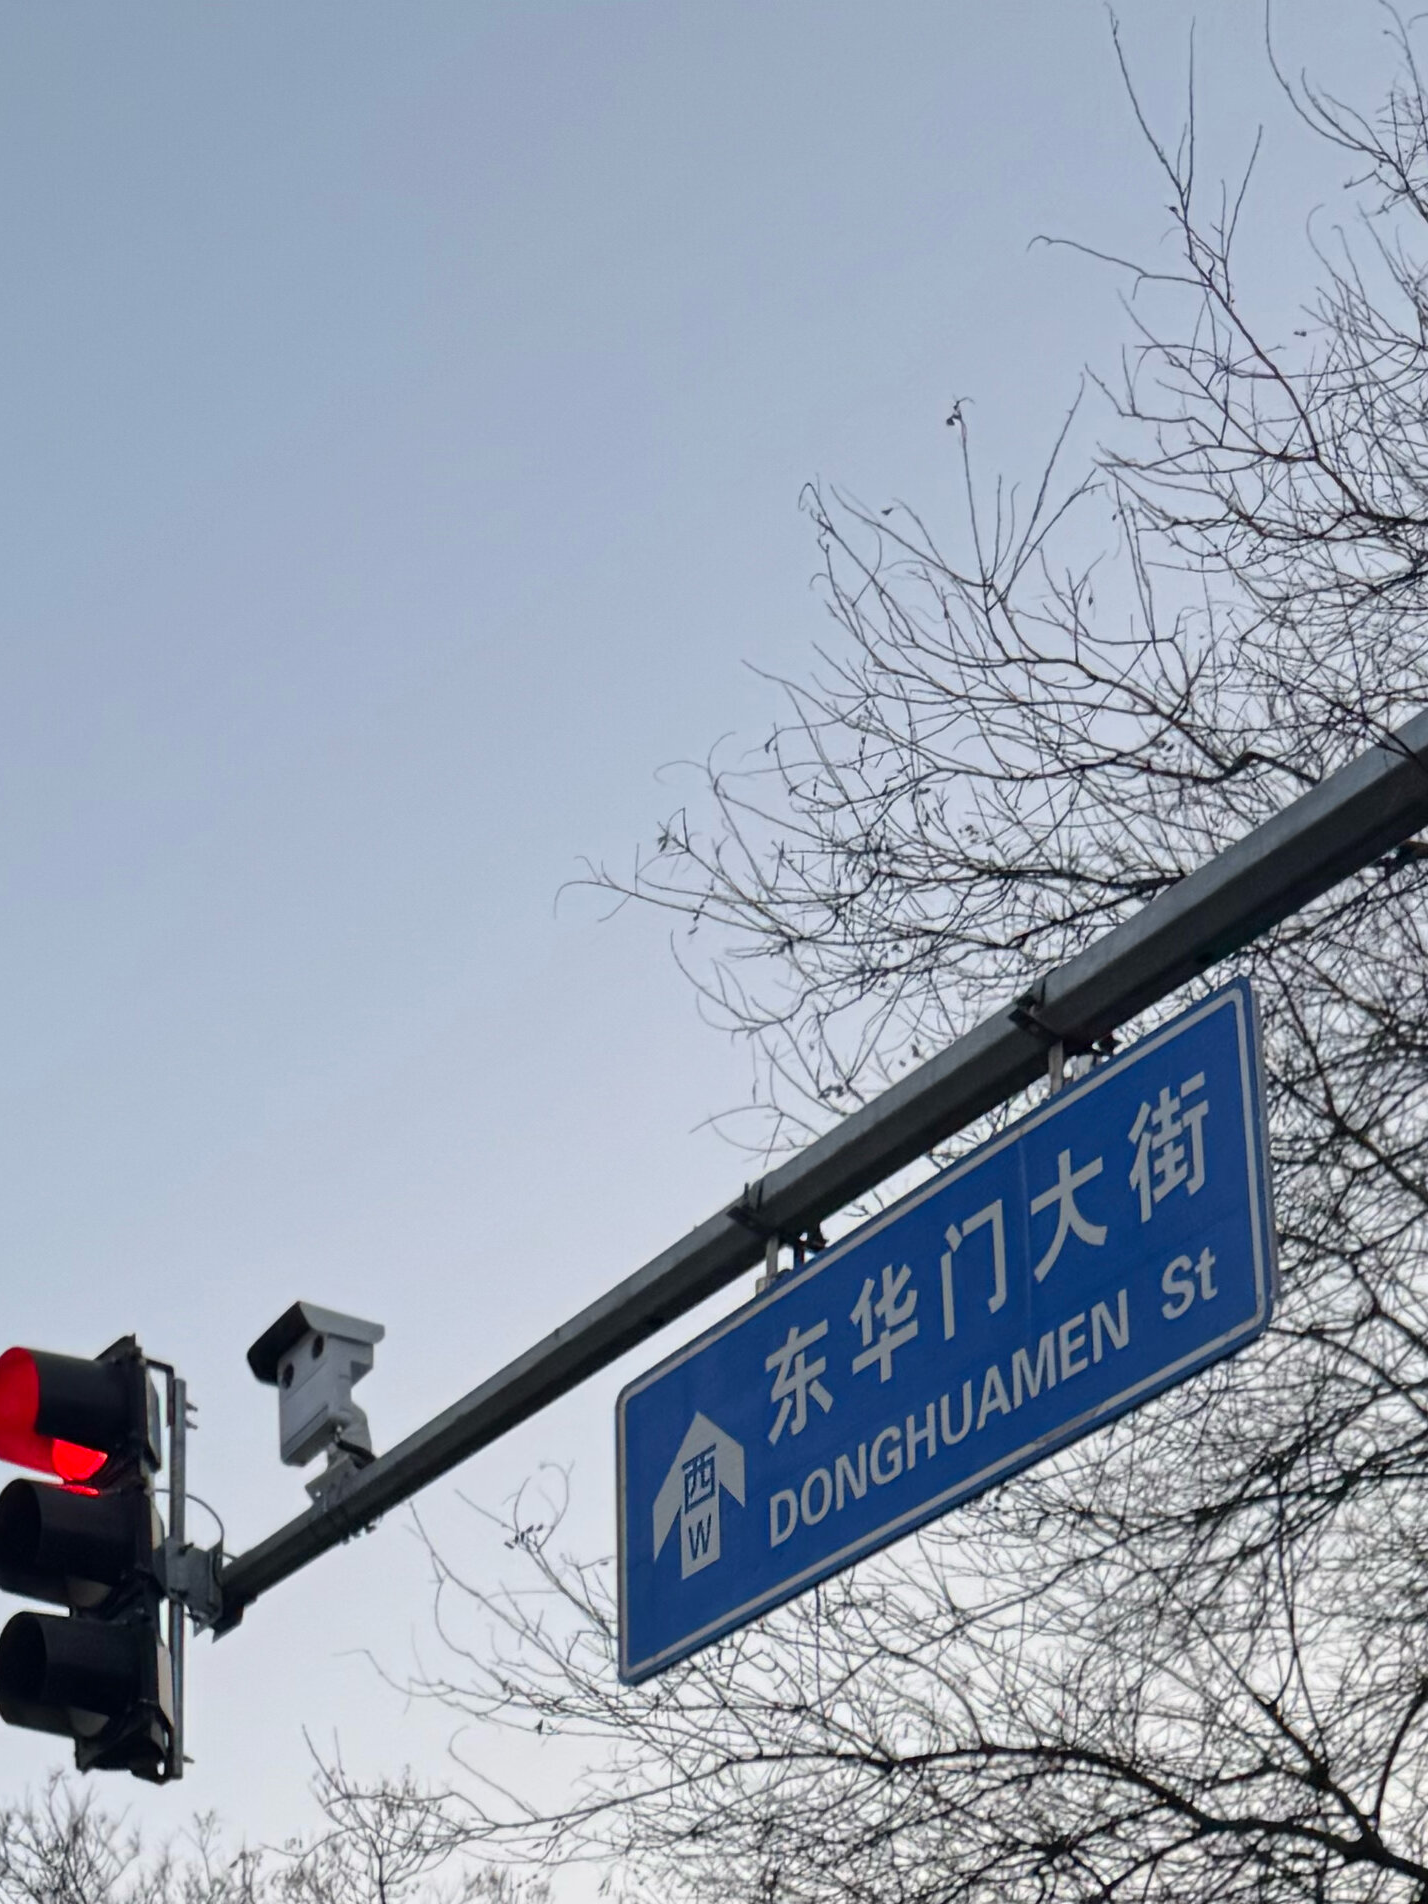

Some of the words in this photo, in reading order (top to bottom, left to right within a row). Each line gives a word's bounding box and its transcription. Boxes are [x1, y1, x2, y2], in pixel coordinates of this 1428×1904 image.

[764, 1071, 1210, 1446] 东华门大街
[682, 1444, 716, 1508] 西
[771, 1290, 1129, 1548] DONGHUAMEN
[1161, 1245, 1218, 1321] St
[688, 1514, 712, 1558] W
